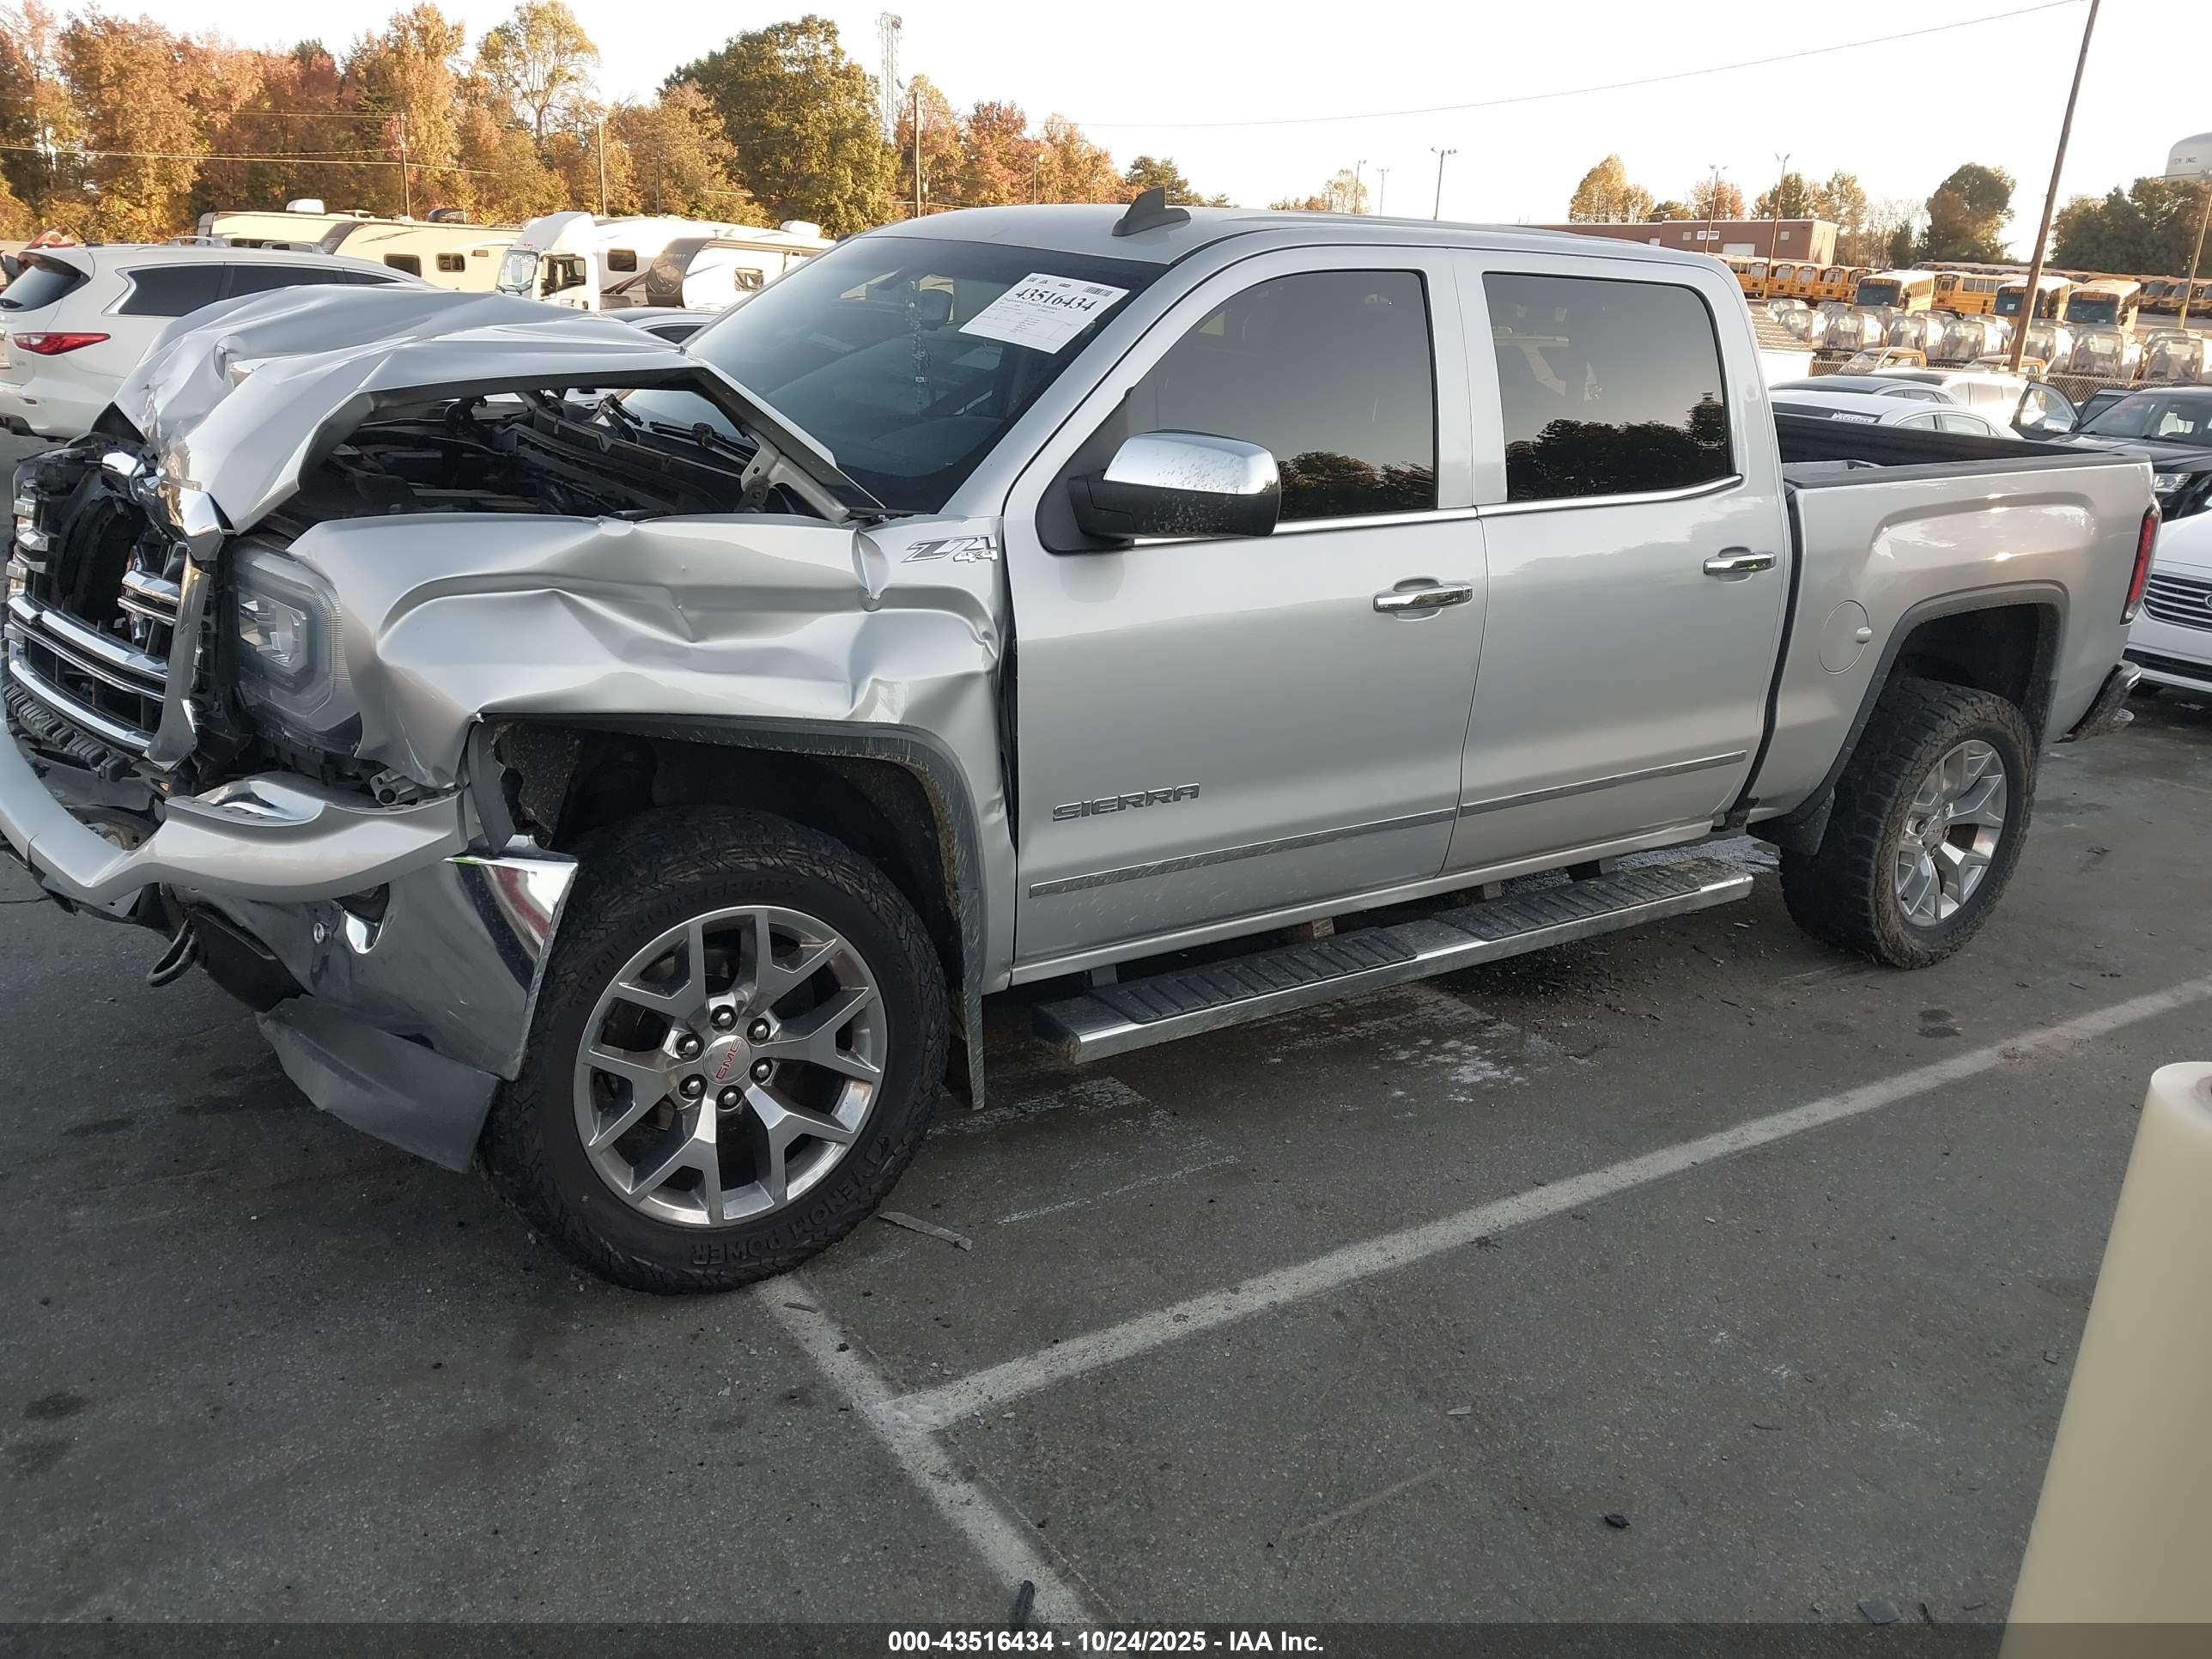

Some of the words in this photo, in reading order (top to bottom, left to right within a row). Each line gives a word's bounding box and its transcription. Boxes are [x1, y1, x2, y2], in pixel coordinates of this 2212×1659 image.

[1015, 288, 1098, 312] 43516434
[901, 533, 998, 563] Z71
[1052, 781, 1200, 823] SIERRA
[715, 1037, 741, 1080] GMC
[691, 1230, 781, 1266] POWER
